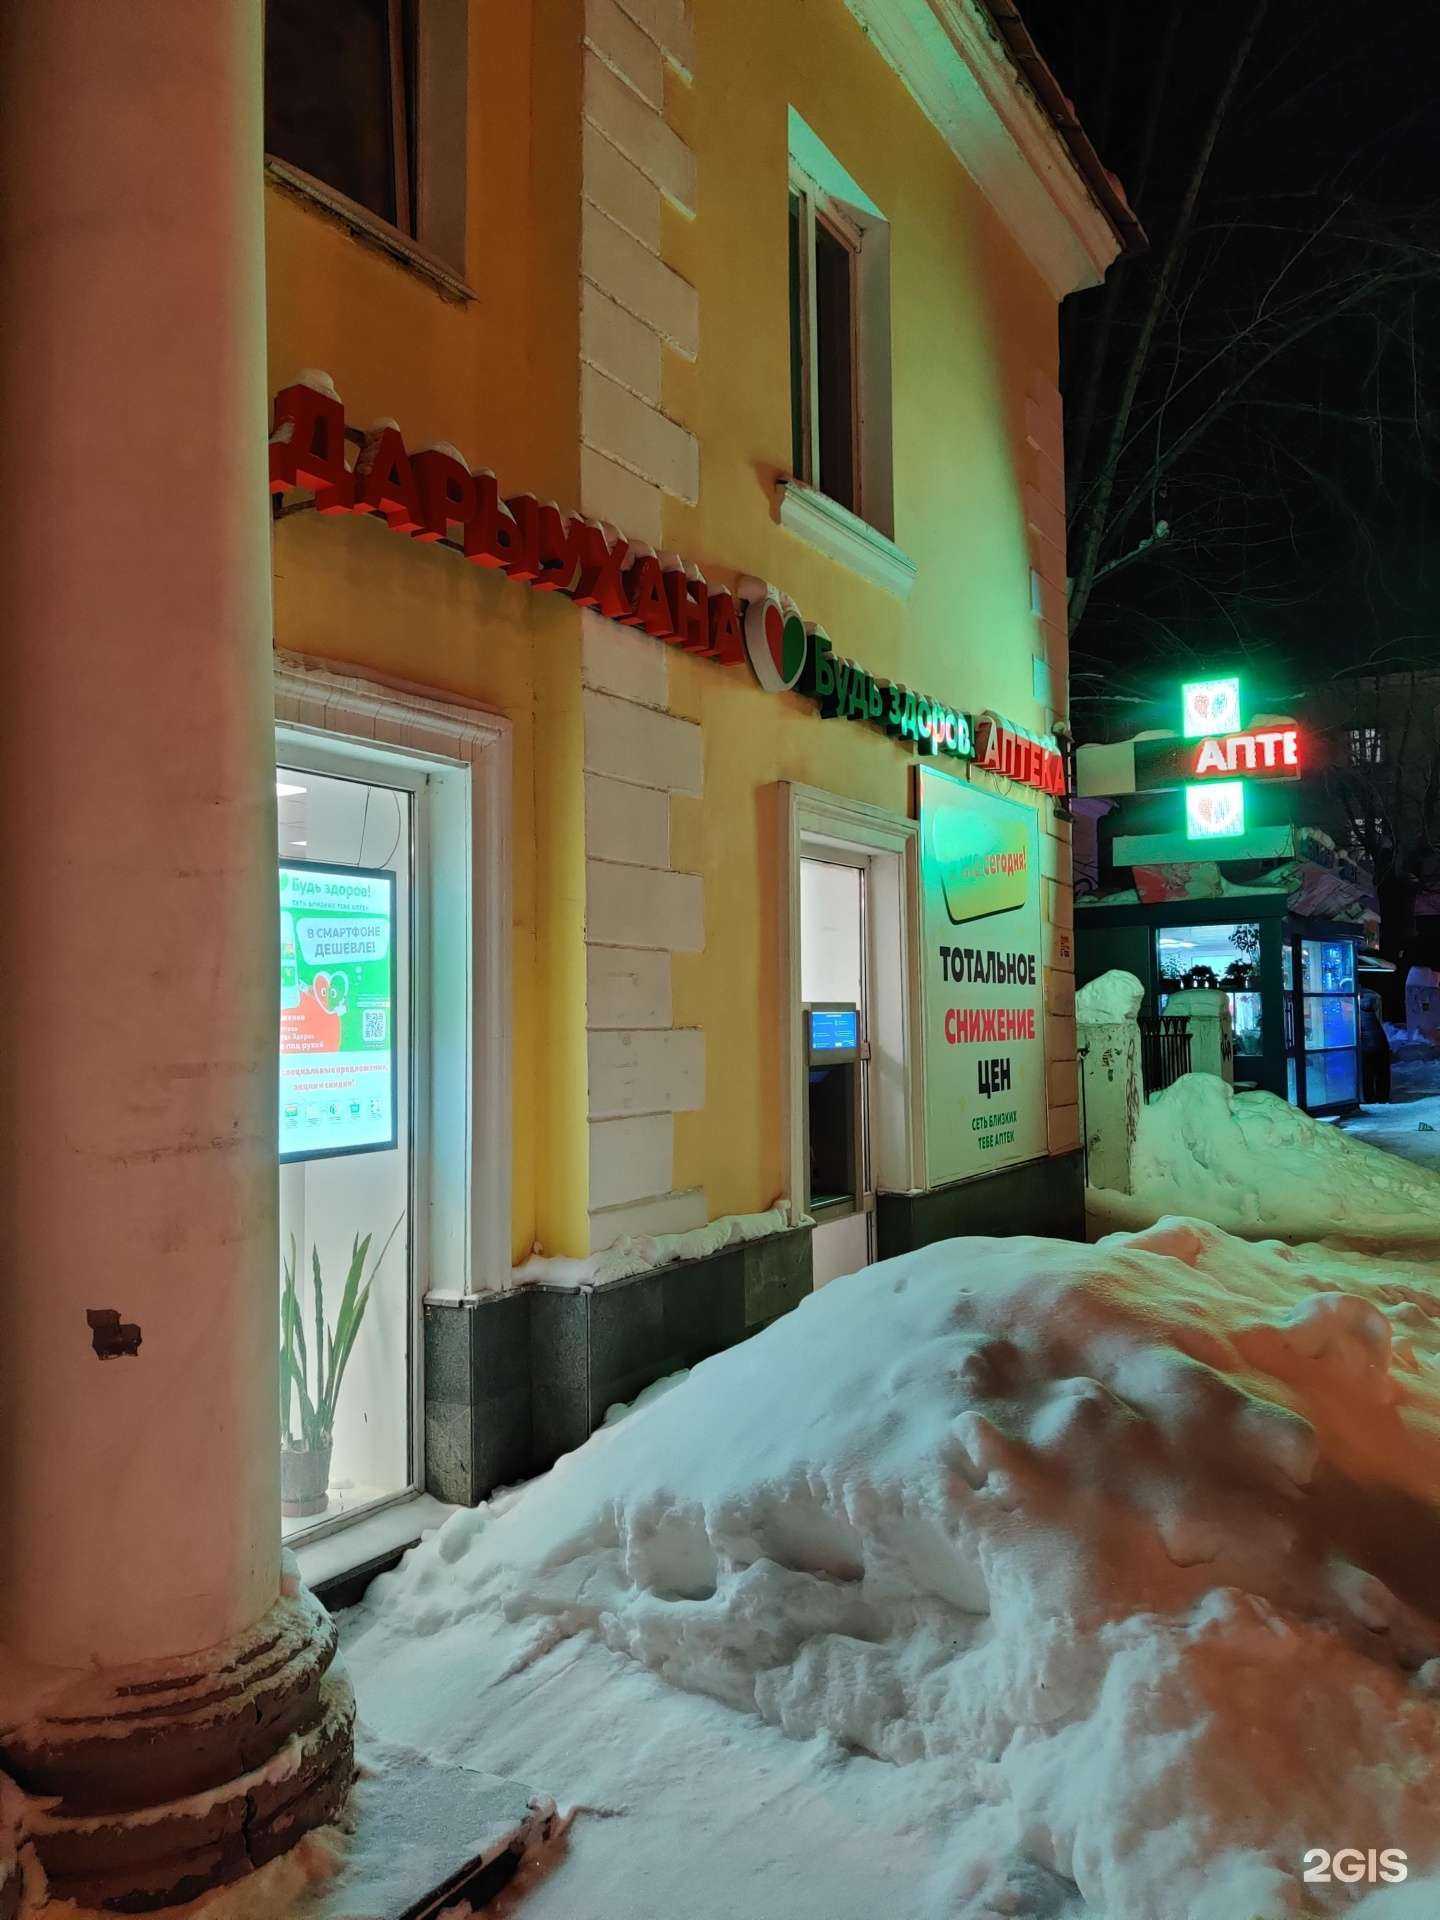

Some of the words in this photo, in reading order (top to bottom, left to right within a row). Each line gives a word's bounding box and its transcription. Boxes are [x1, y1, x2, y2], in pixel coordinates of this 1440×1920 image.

[814, 633, 883, 718] Будь
[887, 685, 976, 758] здоров!
[975, 716, 1066, 796] АПТЕКА
[292, 878, 321, 895] Будь
[307, 928, 314, 939] В
[316, 926, 381, 939] СМАРТФОНЕ
[315, 941, 376, 957] ДЕШЕВЛЕ!
[940, 946, 1036, 985] ТОТАЛЬНОЕ
[944, 1008, 1035, 1044] СНИЖЕНИЕ
[978, 1058, 1011, 1099] ЦЕН
[971, 1115, 988, 1131] СЕТЬ
[989, 1110, 1017, 1128] БЛИЗКИХ
[978, 1134, 994, 1150] ТЕБЕ
[995, 1130, 1015, 1146] АПТЕК
